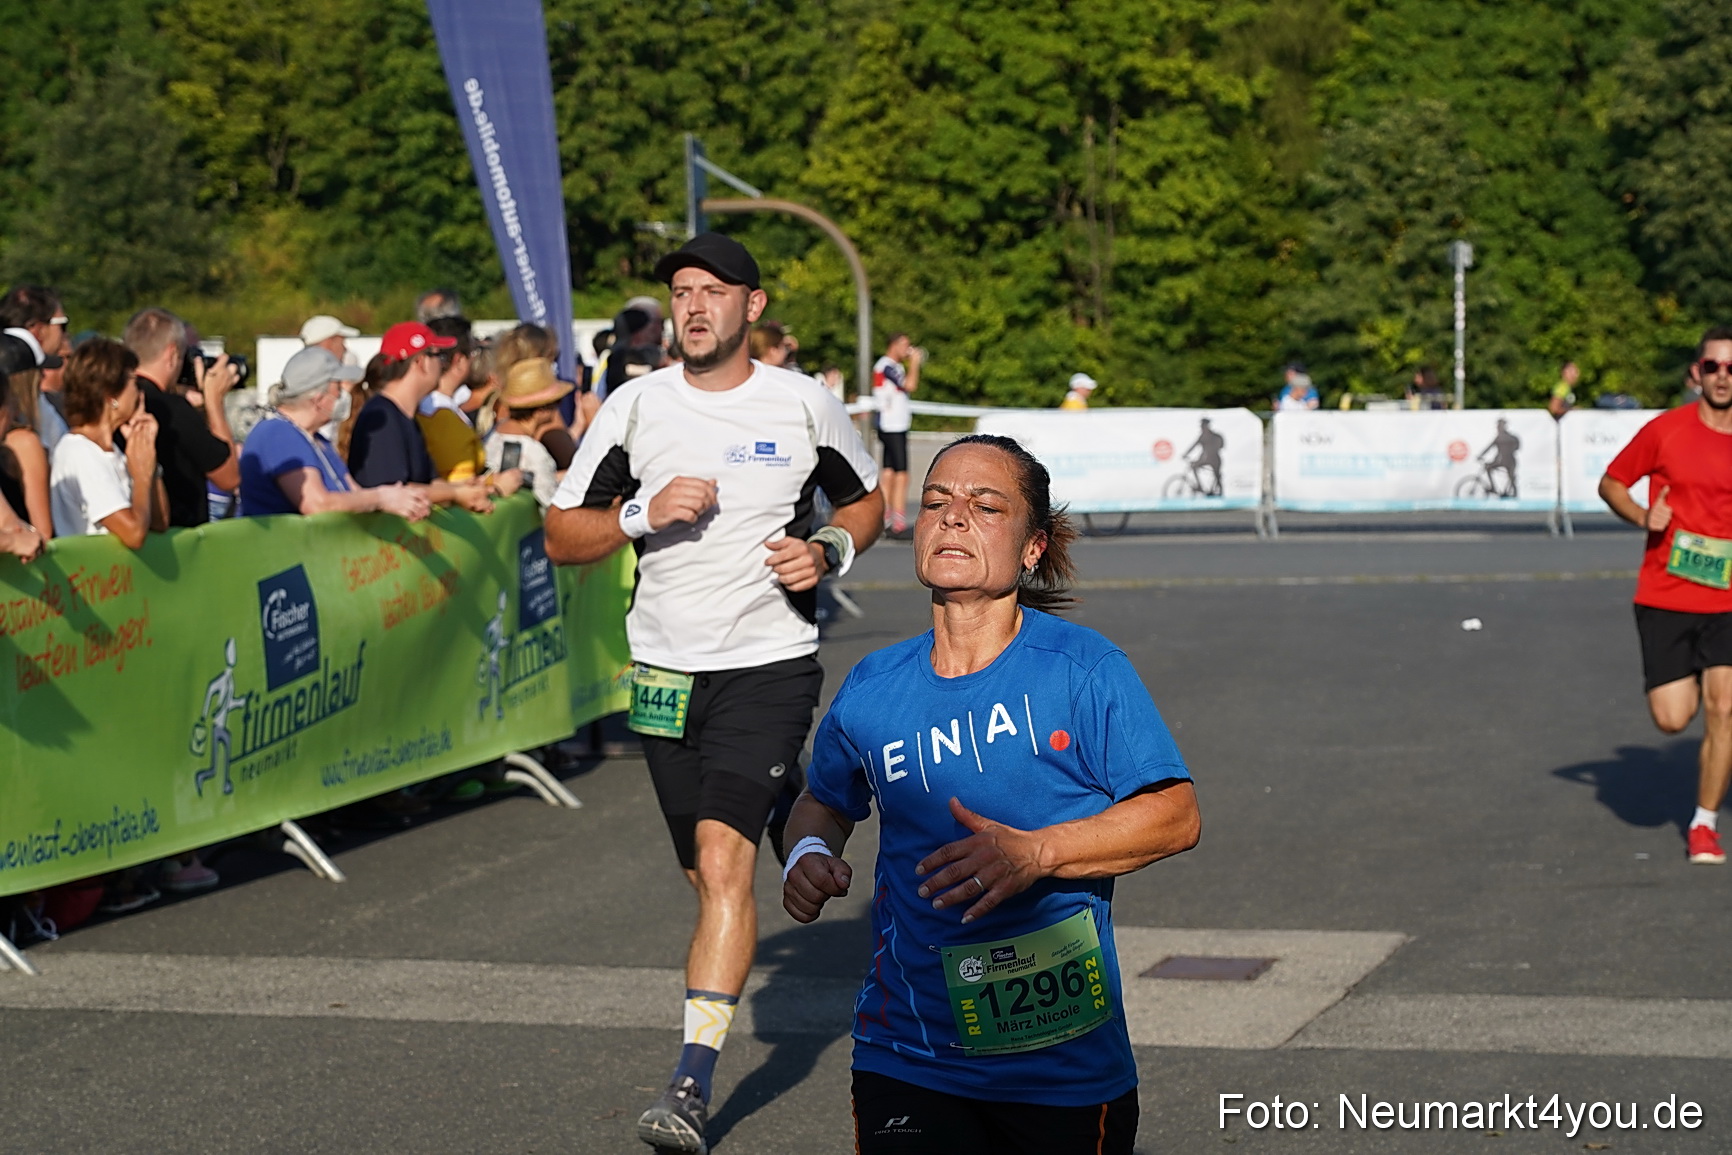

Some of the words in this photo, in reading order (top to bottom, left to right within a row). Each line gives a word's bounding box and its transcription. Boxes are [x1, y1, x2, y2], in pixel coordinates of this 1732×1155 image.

[68, 564, 133, 613] Firmen
[16, 632, 78, 695] laufen
[241, 639, 366, 757] firmenlauf
[986, 953, 1036, 974] Firmenlauf
[1008, 962, 1037, 975] neumarkt
[1085, 956, 1105, 1010] 2022
[979, 960, 1085, 1019] 1296
[961, 998, 982, 1036] RUN
[997, 1017, 1033, 1034] März
[1036, 1004, 1081, 1027] Nicole
